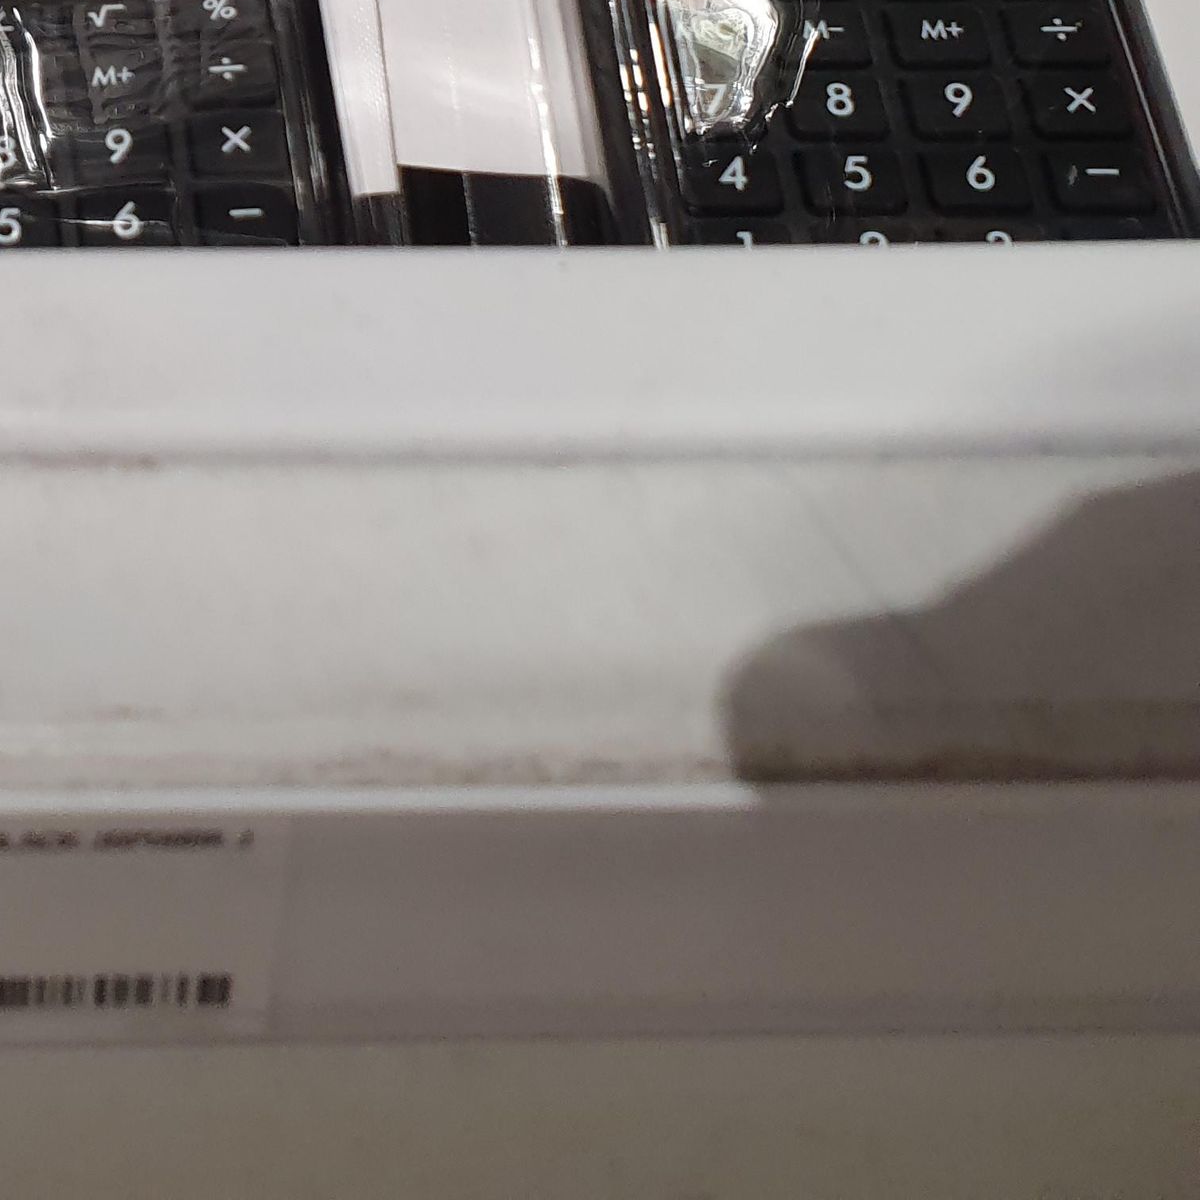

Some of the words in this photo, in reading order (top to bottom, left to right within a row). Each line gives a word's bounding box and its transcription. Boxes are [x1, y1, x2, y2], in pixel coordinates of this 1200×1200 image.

[920, 20, 964, 41] M+
[92, 67, 135, 89] M+
[826, 83, 856, 117] 8
[943, 83, 975, 118] 9
[104, 128, 133, 164] 9
[718, 155, 750, 192] 4
[843, 155, 873, 192] 5
[966, 155, 996, 192] 6
[113, 201, 145, 240] 6
